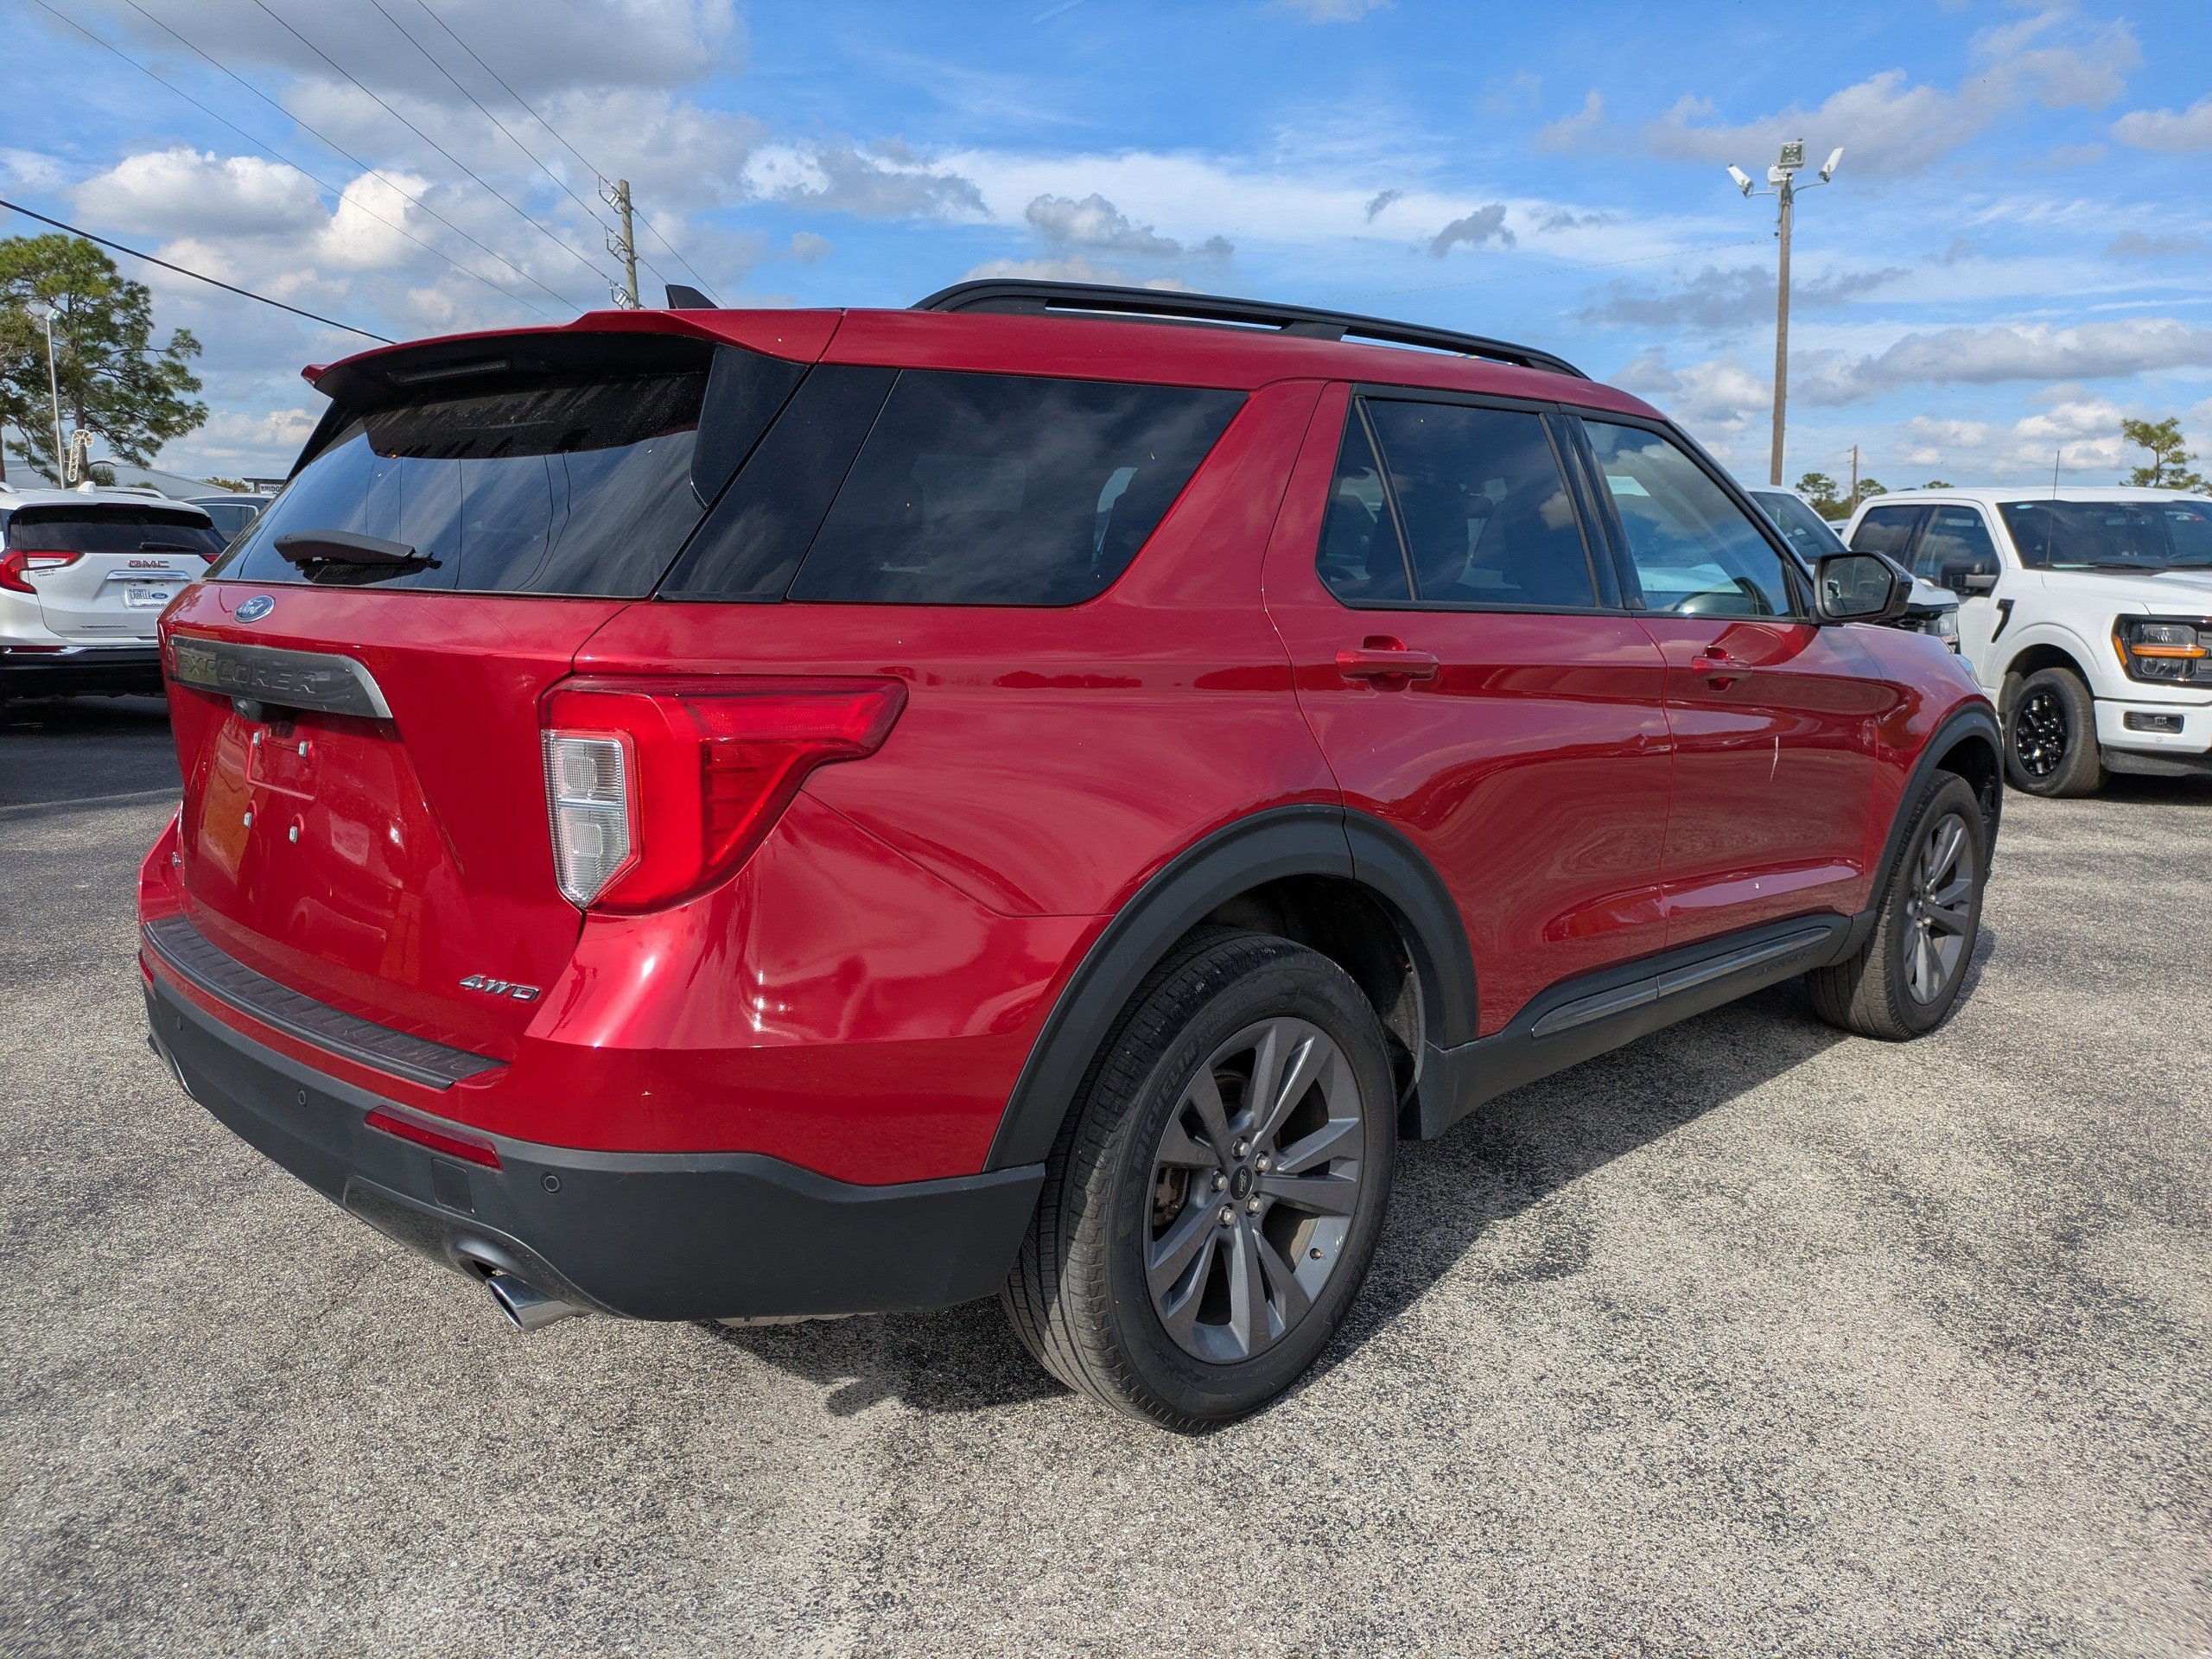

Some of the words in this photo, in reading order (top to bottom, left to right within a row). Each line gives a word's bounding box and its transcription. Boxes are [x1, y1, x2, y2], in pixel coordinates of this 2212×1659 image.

[128, 560, 169, 569] GMC
[236, 597, 268, 618] Ford
[180, 653, 318, 695] EXPLORER
[459, 974, 542, 1001] 4WD
[1134, 1041, 1198, 1173] MICHELIN
